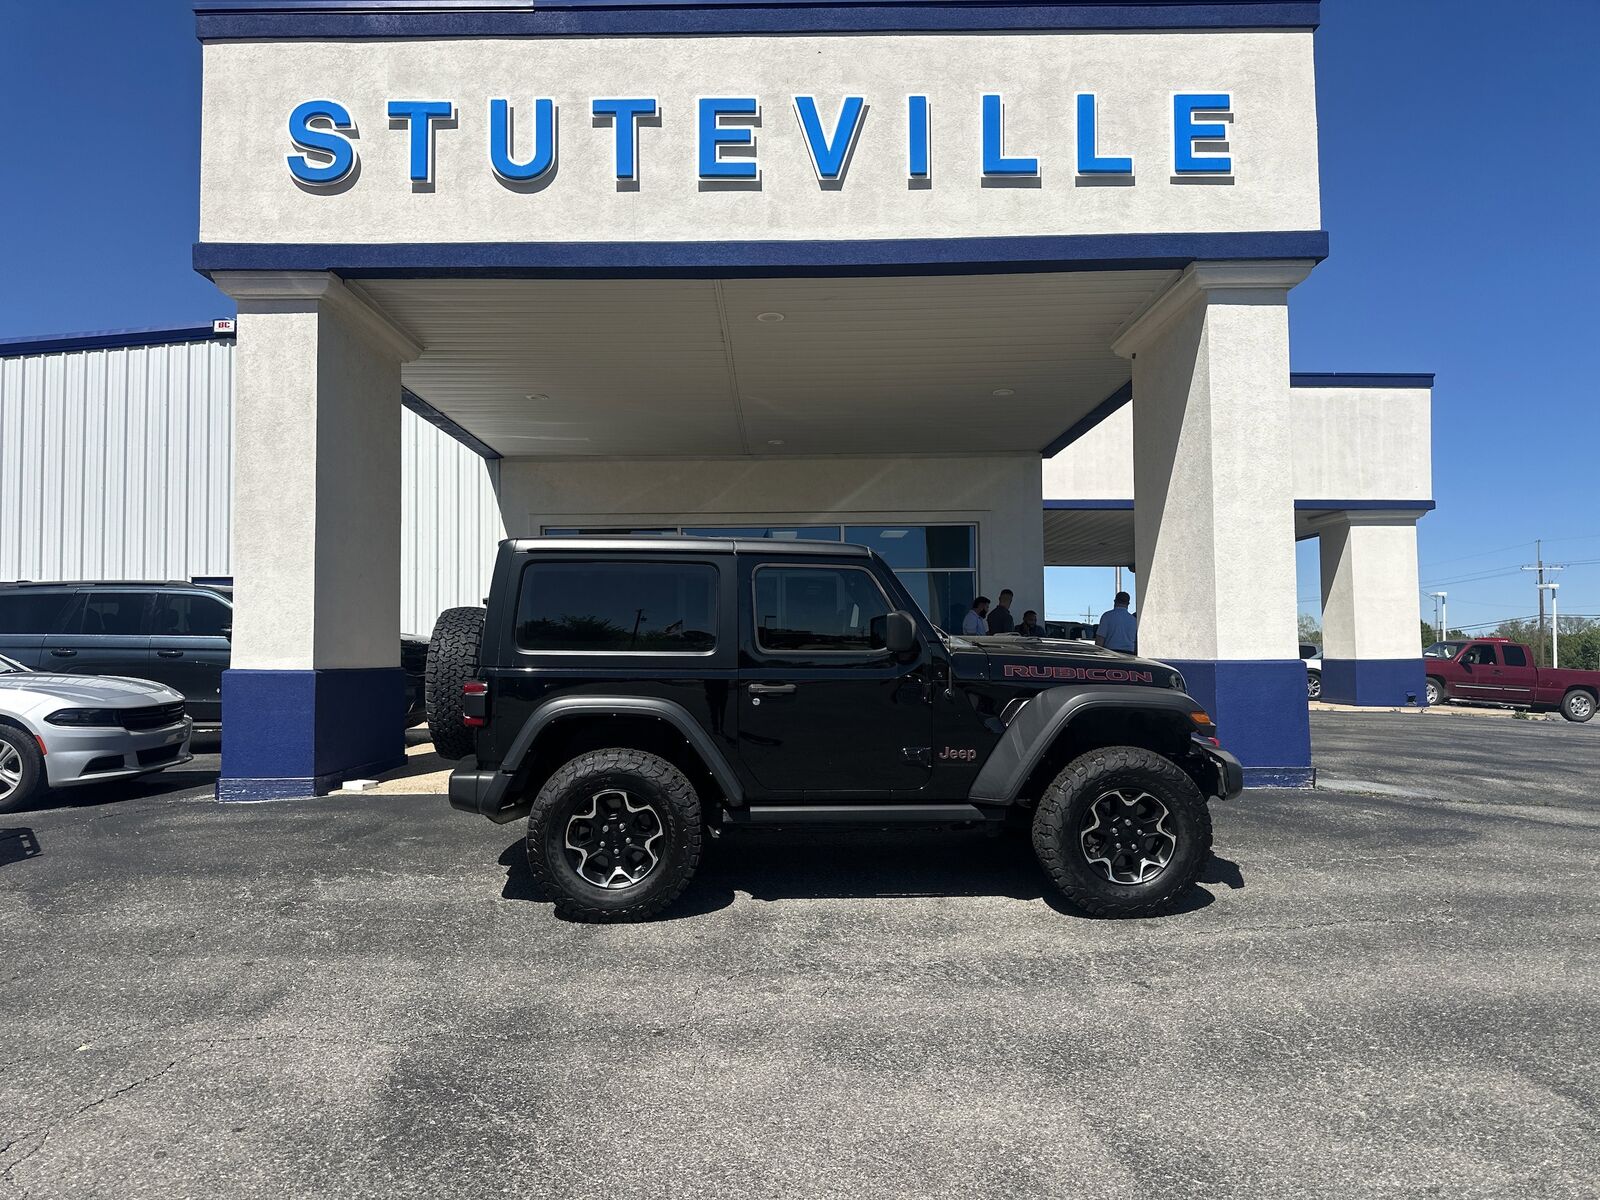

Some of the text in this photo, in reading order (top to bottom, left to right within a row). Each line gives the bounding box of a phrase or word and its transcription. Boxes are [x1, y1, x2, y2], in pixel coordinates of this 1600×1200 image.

[286, 92, 1233, 187] STUTEVILLE
[1003, 664, 1153, 683] RUBICON
[939, 746, 977, 761] Jeep
